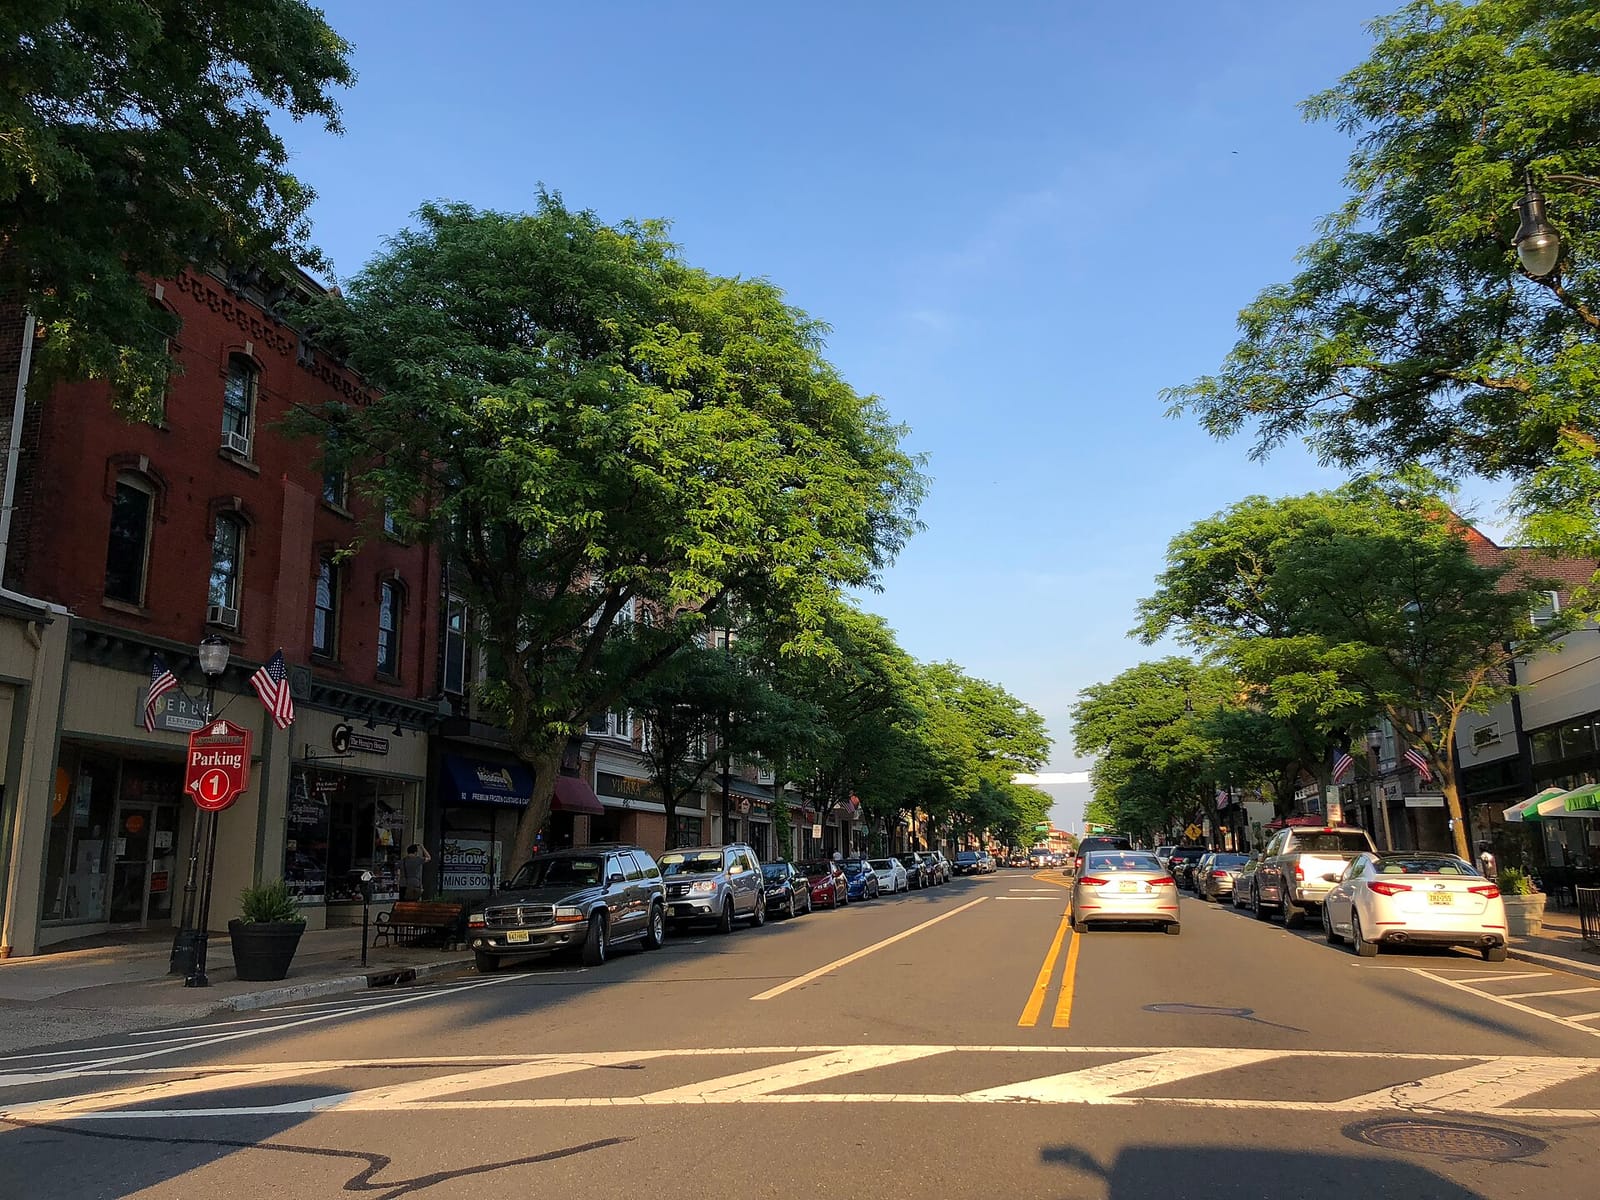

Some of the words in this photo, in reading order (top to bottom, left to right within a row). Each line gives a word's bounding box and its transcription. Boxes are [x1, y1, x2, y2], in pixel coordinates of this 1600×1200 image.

[167, 716, 203, 727] ELECTROLU
[191, 751, 241, 768] Parking
[209, 775, 219, 795] 1
[441, 851, 489, 865] eadows
